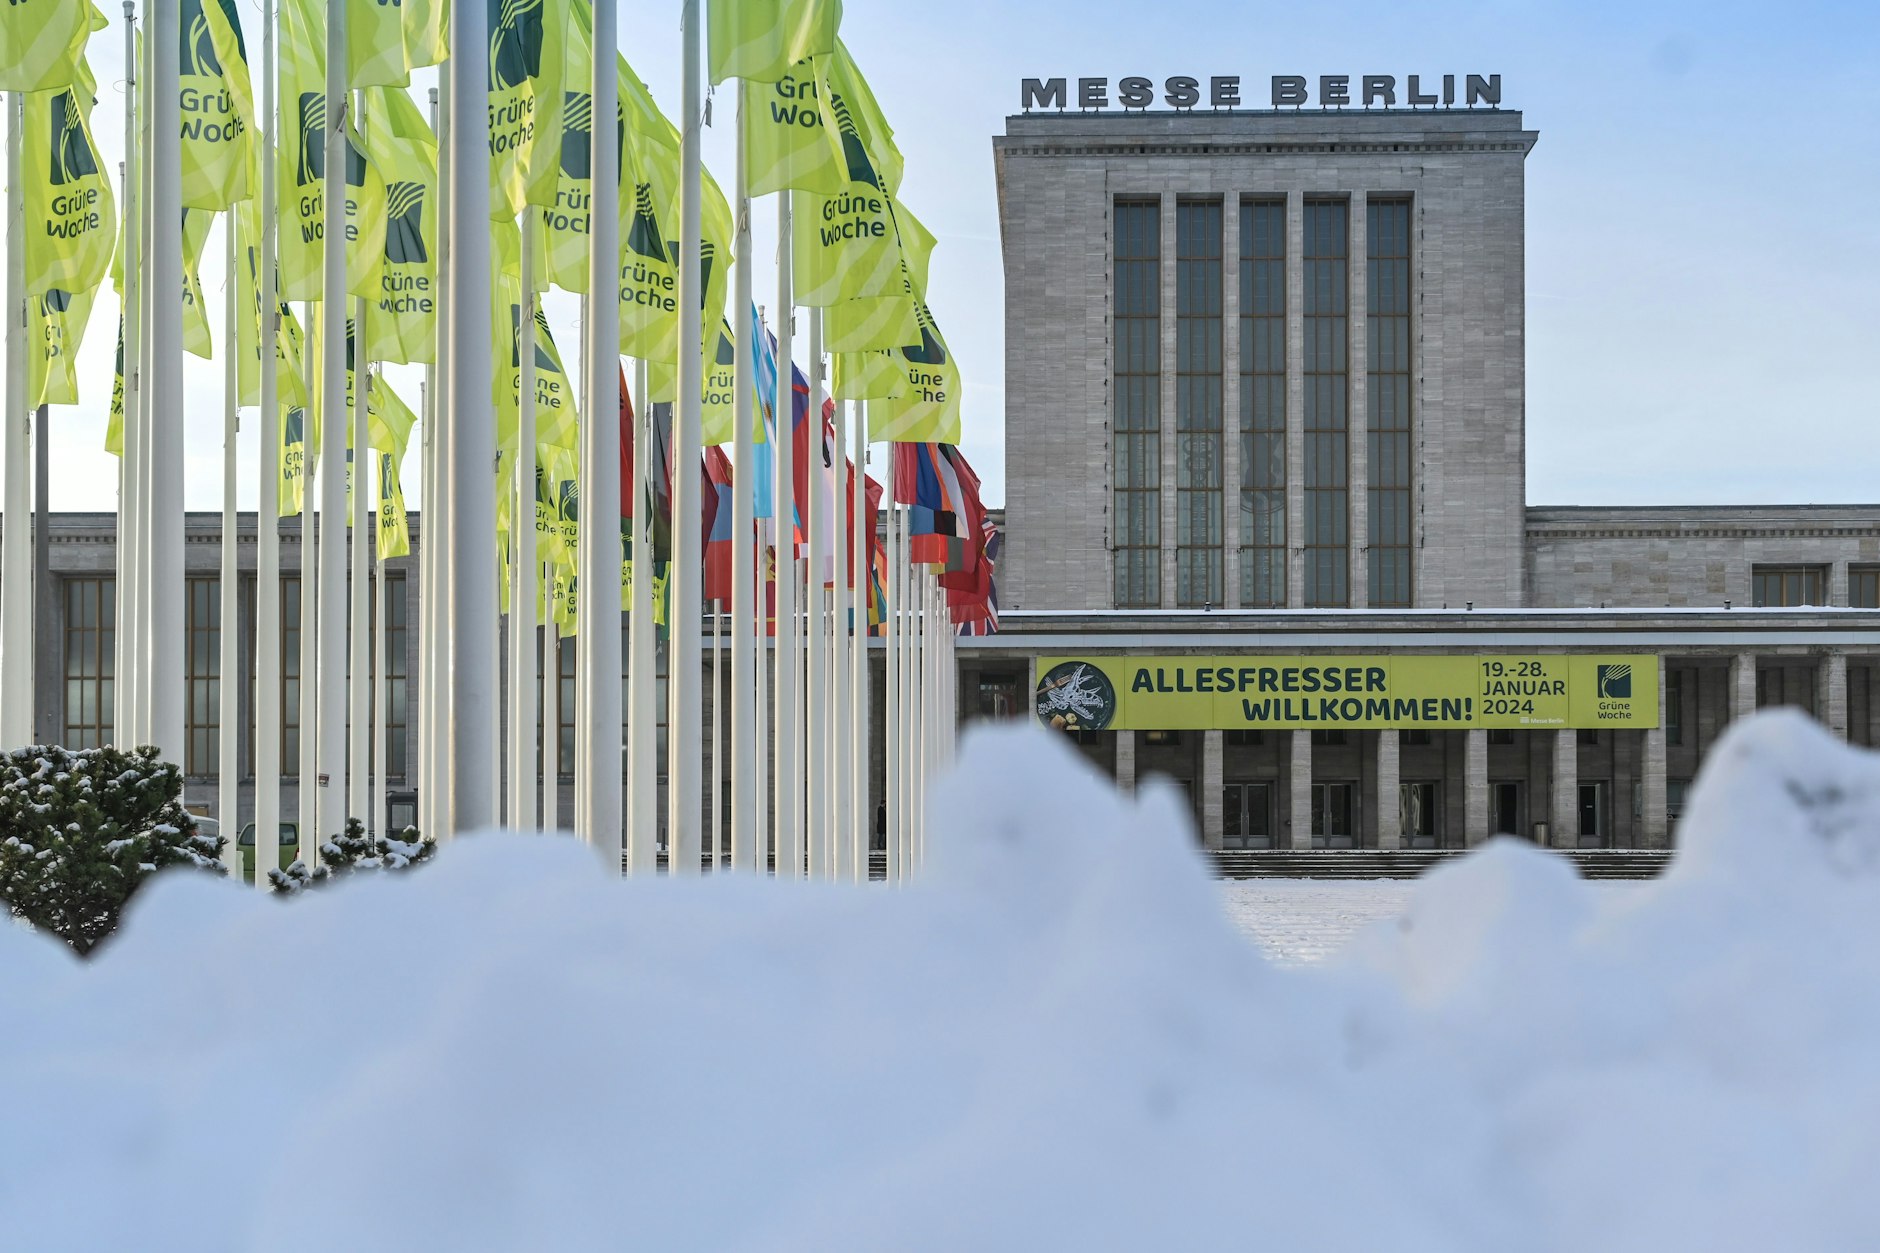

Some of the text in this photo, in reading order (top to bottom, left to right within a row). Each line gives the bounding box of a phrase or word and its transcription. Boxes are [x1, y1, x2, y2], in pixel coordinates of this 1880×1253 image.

[1021, 74, 1501, 108] MESSE BERLIN
[51, 189, 98, 216] Grüne
[822, 192, 882, 222] Grüne
[46, 212, 99, 239] Woche
[820, 216, 886, 248] Woche
[621, 261, 674, 291] rüne
[619, 287, 676, 313] oche
[909, 369, 944, 386] üne
[1131, 667, 1387, 693] ALLESFRESSER
[1482, 661, 1548, 678] 19.-28.
[1482, 680, 1566, 697] JANUAR
[1242, 697, 1473, 721] WILLKOMMEN!
[1483, 699, 1535, 715] 2024
[1597, 710, 1632, 720] Woche
[1598, 701, 1631, 711] Grüne
